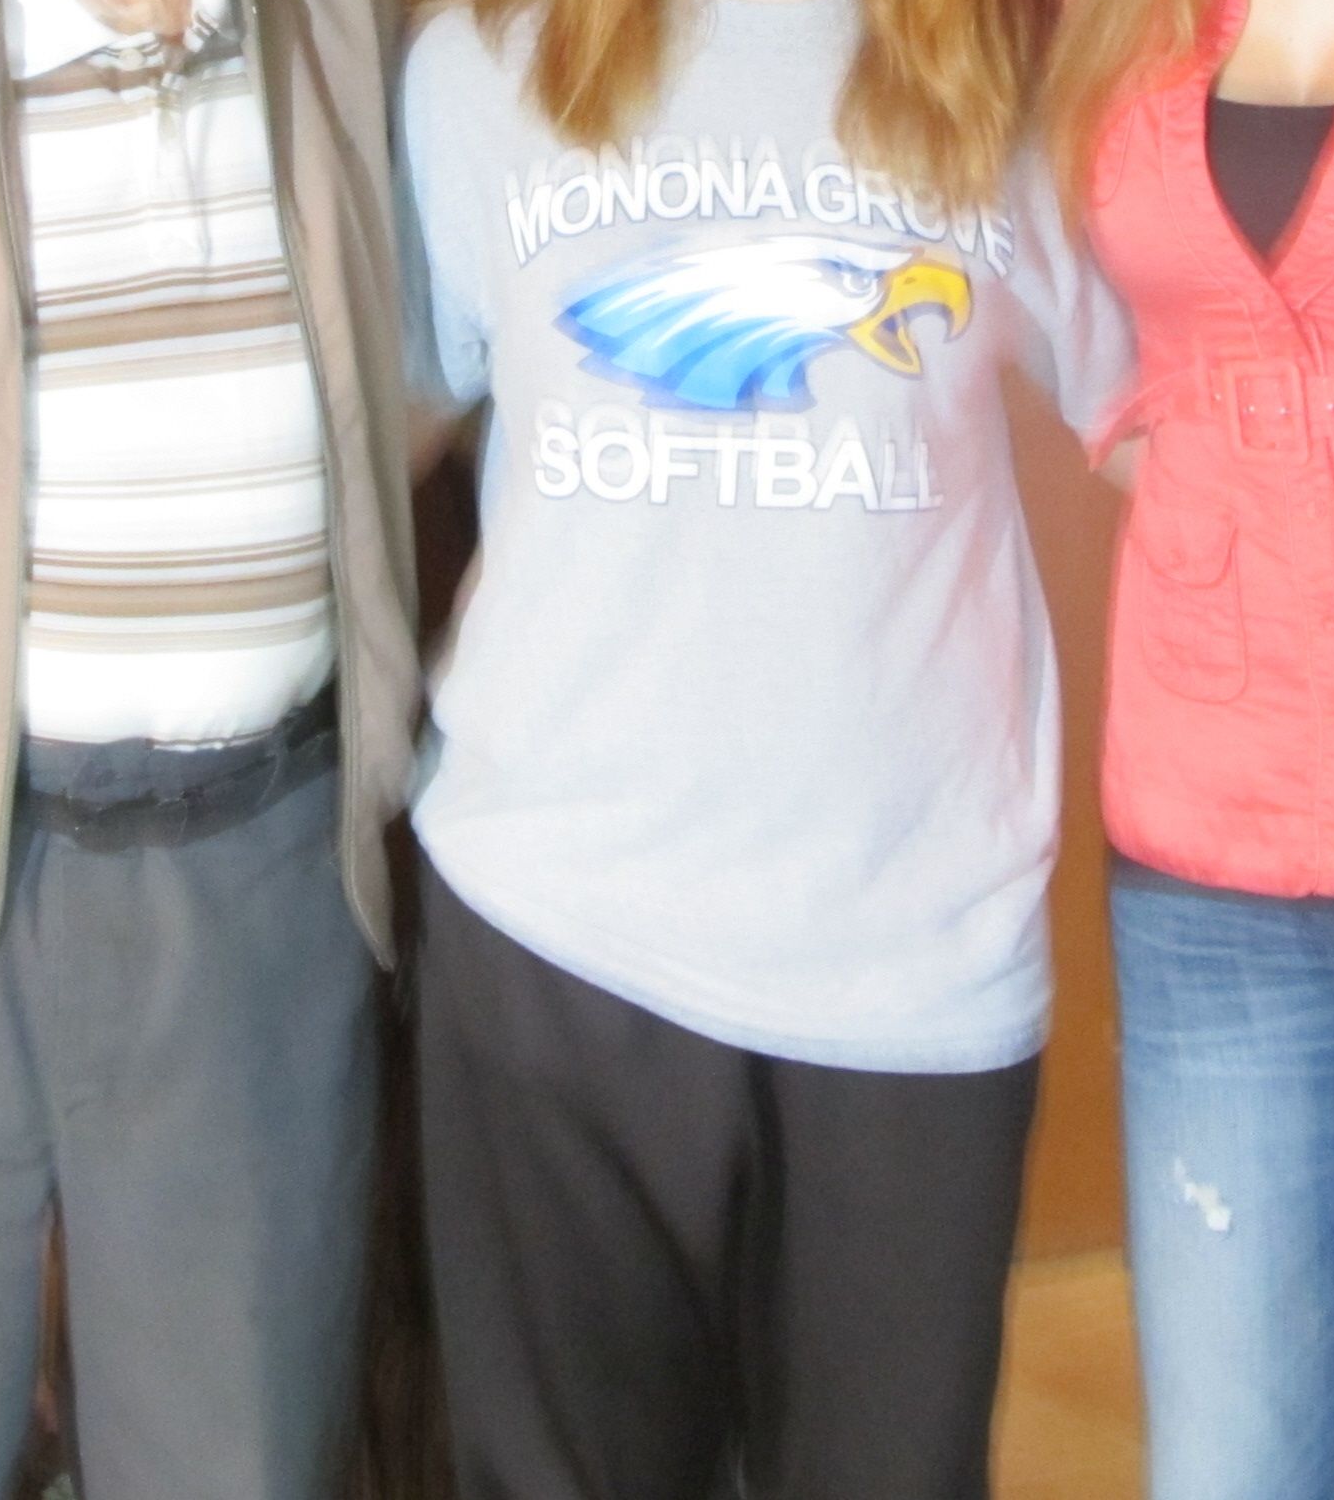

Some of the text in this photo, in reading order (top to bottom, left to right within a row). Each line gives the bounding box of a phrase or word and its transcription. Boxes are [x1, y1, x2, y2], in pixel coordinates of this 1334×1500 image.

[505, 158, 1015, 279] MONONA GROVE
[534, 425, 944, 513] SOFTBALL
